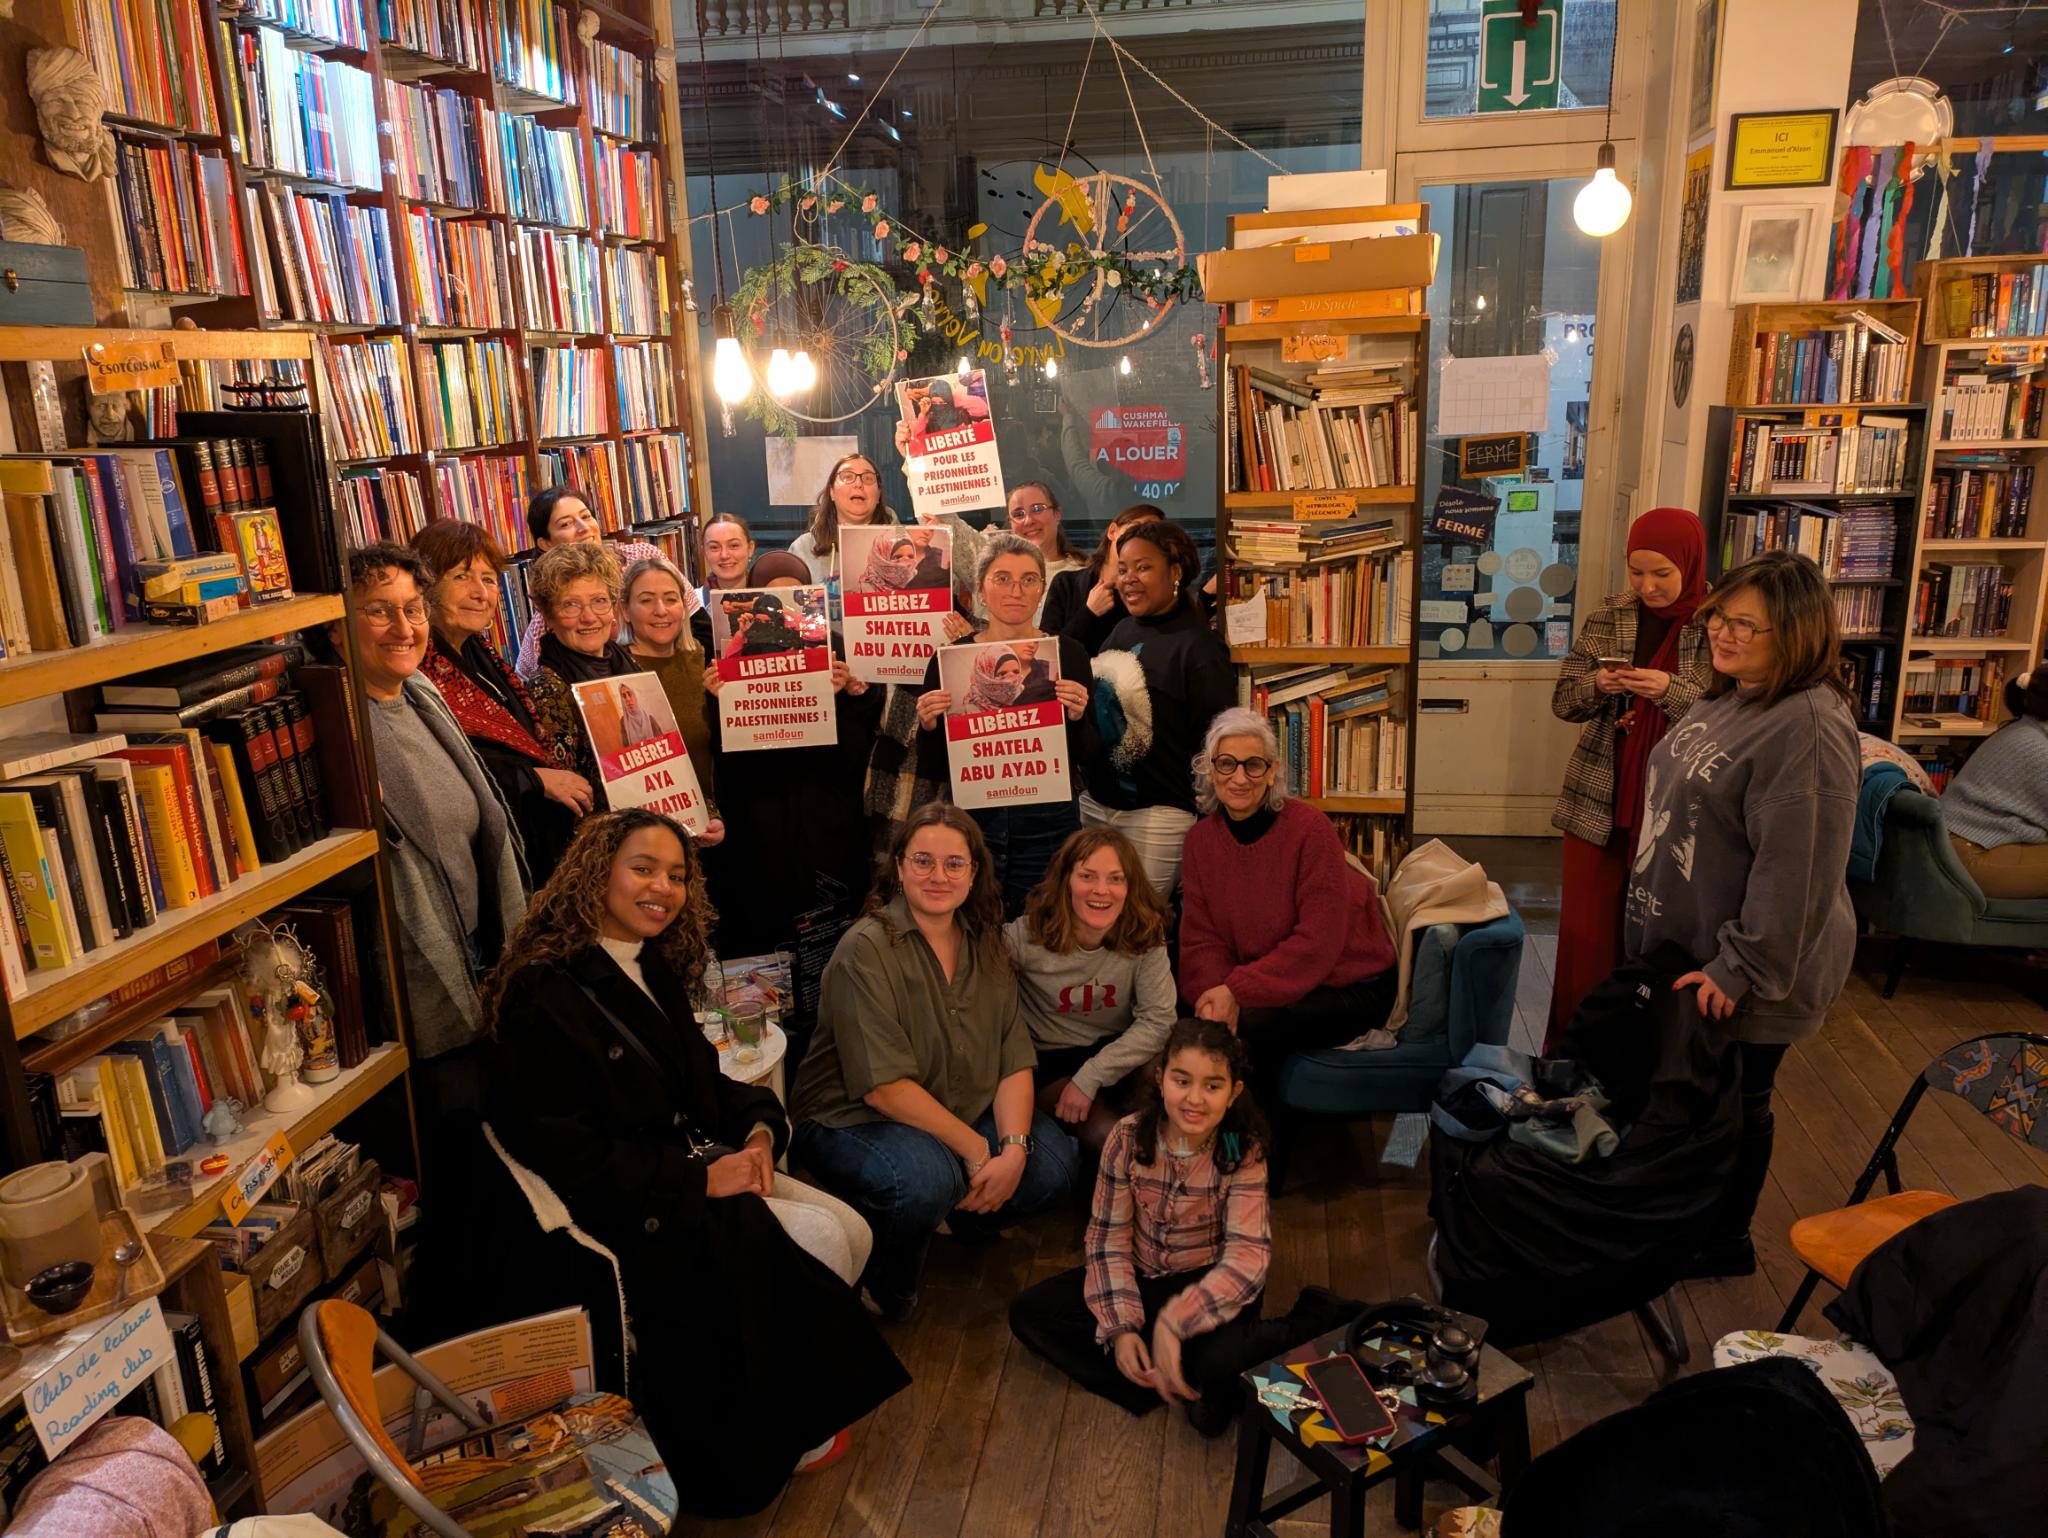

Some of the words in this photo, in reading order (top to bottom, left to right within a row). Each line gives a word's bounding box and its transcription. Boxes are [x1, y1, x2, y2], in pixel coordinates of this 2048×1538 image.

[1774, 132, 1789, 142] ICI
[1750, 146, 1786, 155] Emmanuel
[1298, 300, 1321, 313] 200
[1322, 299, 1359, 313] Spiele
[925, 424, 976, 452] LIBERTÉ
[933, 454, 959, 466] POUR
[961, 451, 976, 462] LES
[1096, 447, 1110, 461] A
[1115, 446, 1179, 461] LOUER
[1467, 439, 1518, 465] FERMÉ
[924, 463, 989, 481] PRISONNIÈRES
[918, 477, 991, 496] PALESTINIENNES
[1142, 483, 1160, 499] 40
[1436, 517, 1486, 539] FERMÉ
[863, 590, 930, 613] LIBÉREZ
[866, 620, 931, 636] SHATELA
[854, 642, 885, 657] ABU
[891, 643, 934, 658] AYAD
[739, 650, 806, 677] LIBERTÉ
[876, 664, 924, 676] samidoun
[747, 683, 780, 694] POUR
[785, 681, 803, 692] LES
[734, 694, 818, 711] PRISONNIÈRES
[726, 712, 819, 728] PALESTINIENNES
[968, 707, 1041, 735] LIBÉREZ
[753, 729, 804, 741] samidoun
[618, 739, 674, 772] LIBÉREZ
[972, 737, 1043, 758] SHATELA
[960, 764, 995, 782] ABU
[1001, 760, 1047, 779] AYAD
[643, 769, 675, 793] AYA
[986, 785, 1038, 798] samidoun
[184, 784, 199, 822] Planets
[193, 833, 205, 858] Love
[142, 894, 151, 913] LES
[32, 1371, 73, 1414] Club
[76, 1353, 100, 1377] de
[104, 1307, 153, 1353] lecture
[193, 1340, 215, 1407] FONDATION
[46, 1380, 120, 1445] Reading
[122, 1348, 153, 1379] club
